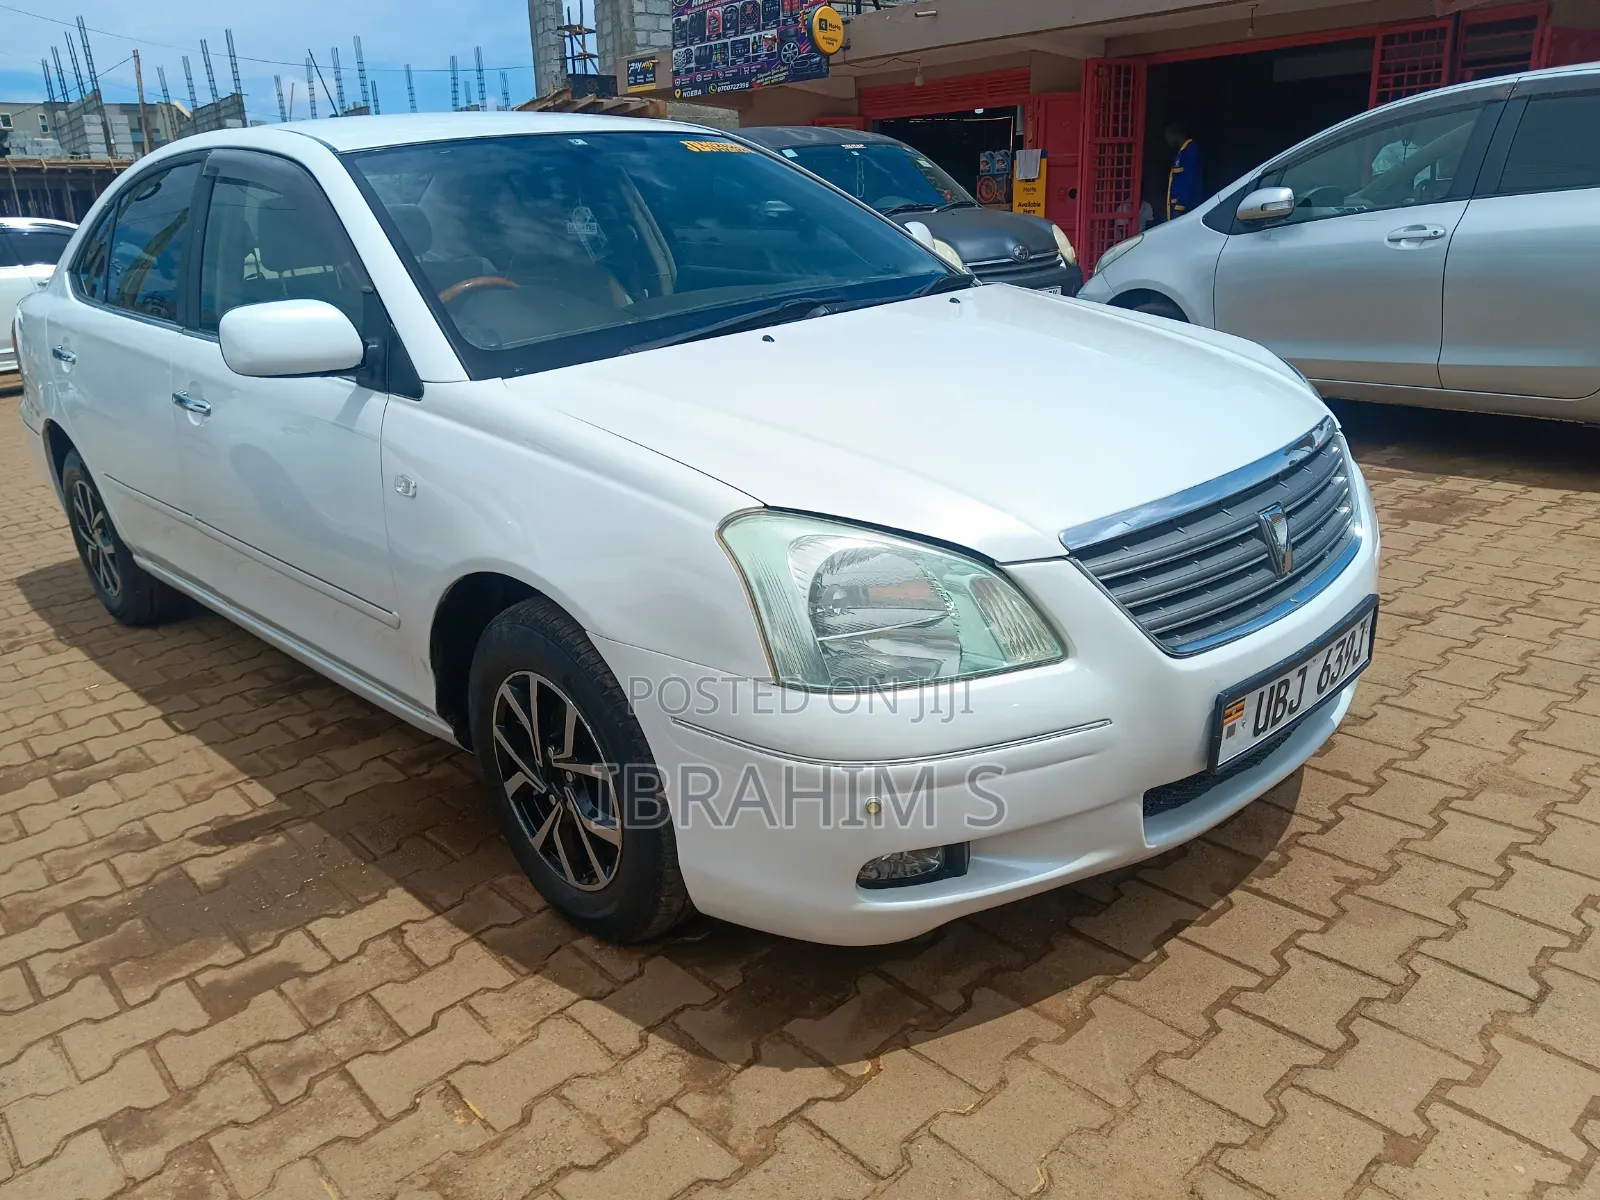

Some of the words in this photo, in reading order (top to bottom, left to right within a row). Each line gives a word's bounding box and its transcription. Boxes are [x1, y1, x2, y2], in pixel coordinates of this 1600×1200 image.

[828, 22, 841, 30] MoMo
[1252, 665, 1308, 738] UBJ
[1316, 619, 1368, 695] 639J
